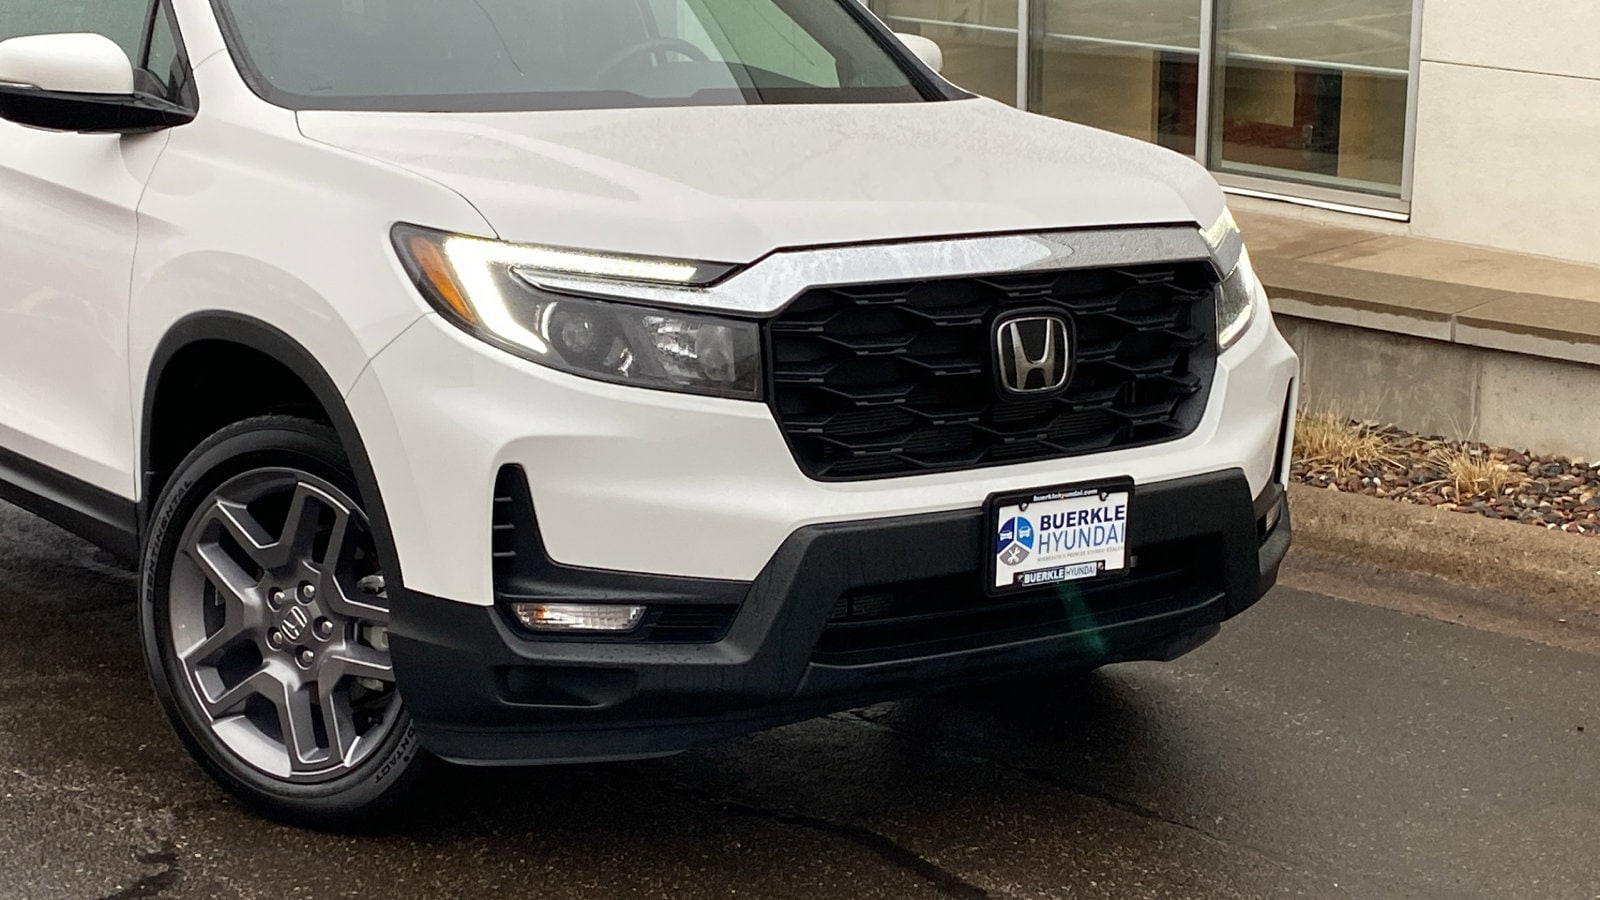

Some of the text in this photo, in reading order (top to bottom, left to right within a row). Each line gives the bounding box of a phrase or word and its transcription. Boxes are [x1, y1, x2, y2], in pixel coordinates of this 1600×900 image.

[1033, 489, 1098, 502] buerklehyundai.com
[1040, 505, 1125, 531] BUERKLE
[146, 480, 193, 603] CONTINENTAL
[1038, 522, 1125, 555] HYUNDAI
[1024, 563, 1095, 583] BUERKLE HYUNDAI
